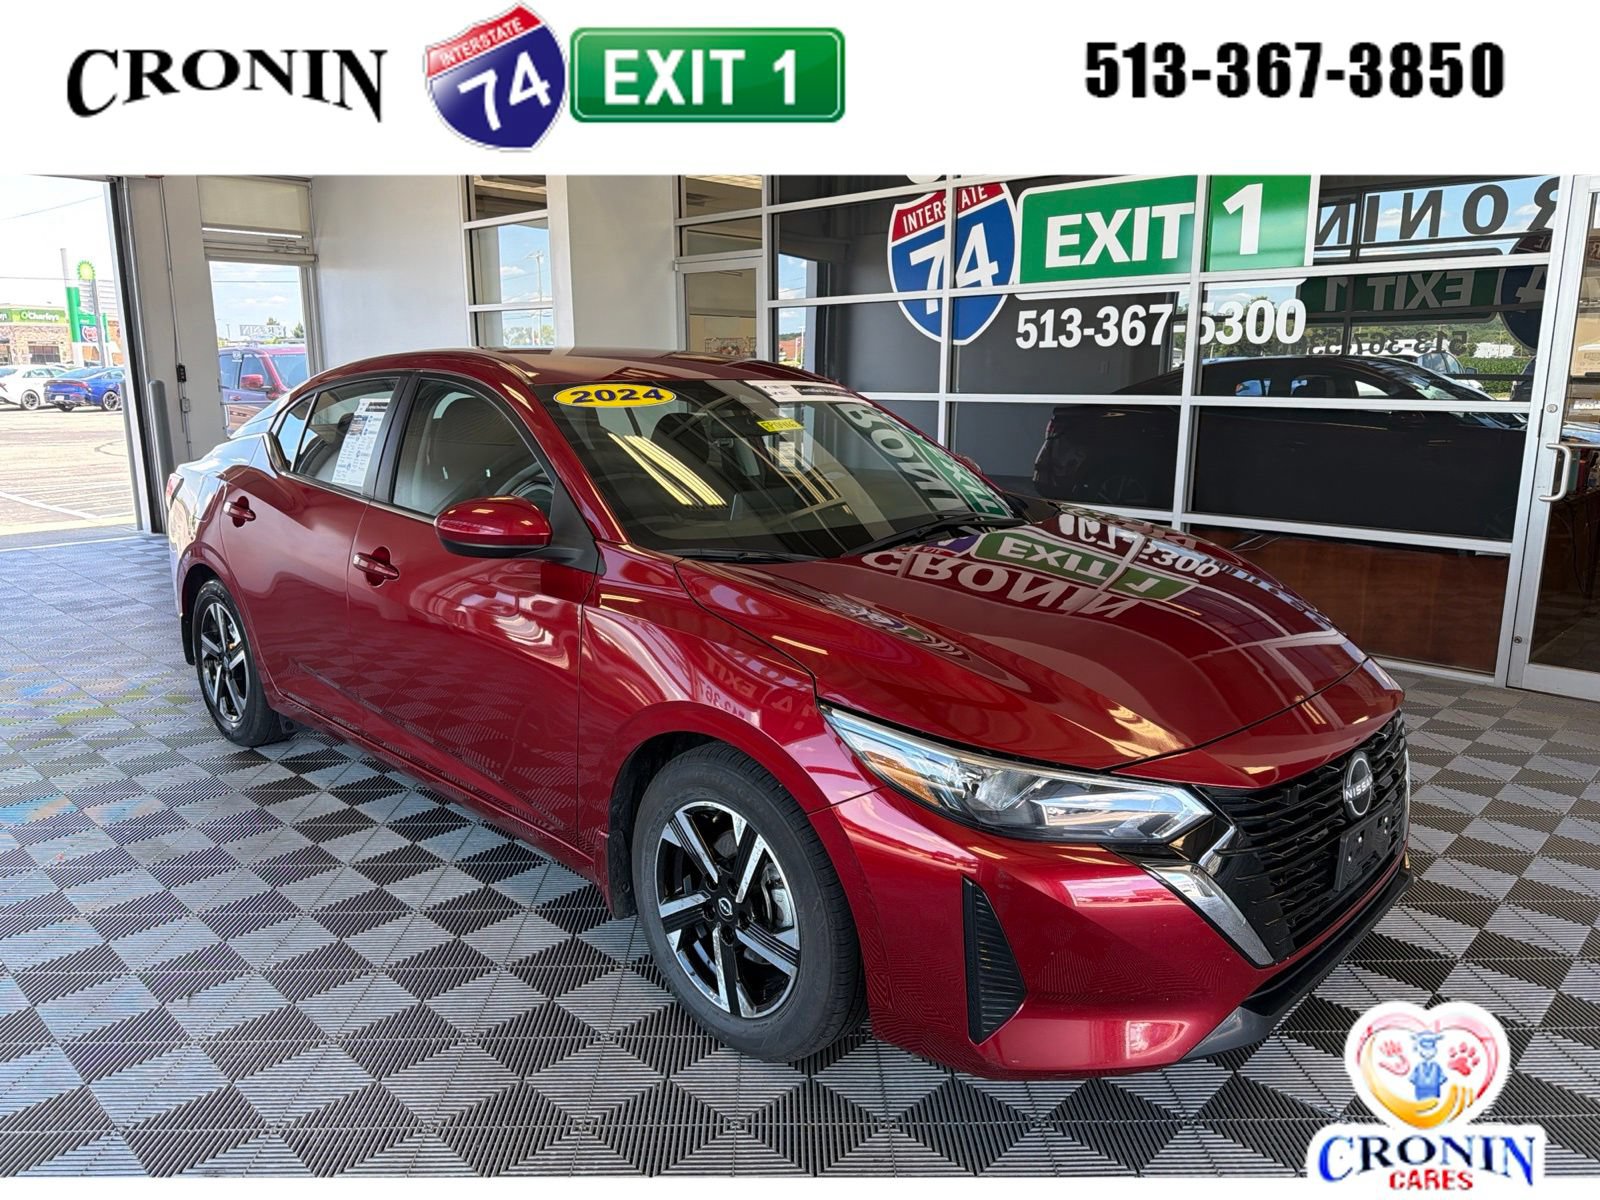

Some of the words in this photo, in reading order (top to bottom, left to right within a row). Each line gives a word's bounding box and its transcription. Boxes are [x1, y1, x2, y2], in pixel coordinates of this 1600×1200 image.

[903, 186, 988, 233] INTERATE
[1045, 202, 1195, 268] EXIT
[1222, 183, 1264, 255] 1
[909, 222, 1000, 315] 74
[570, 388, 665, 404] 2024
[1345, 772, 1373, 800] NISSAN
